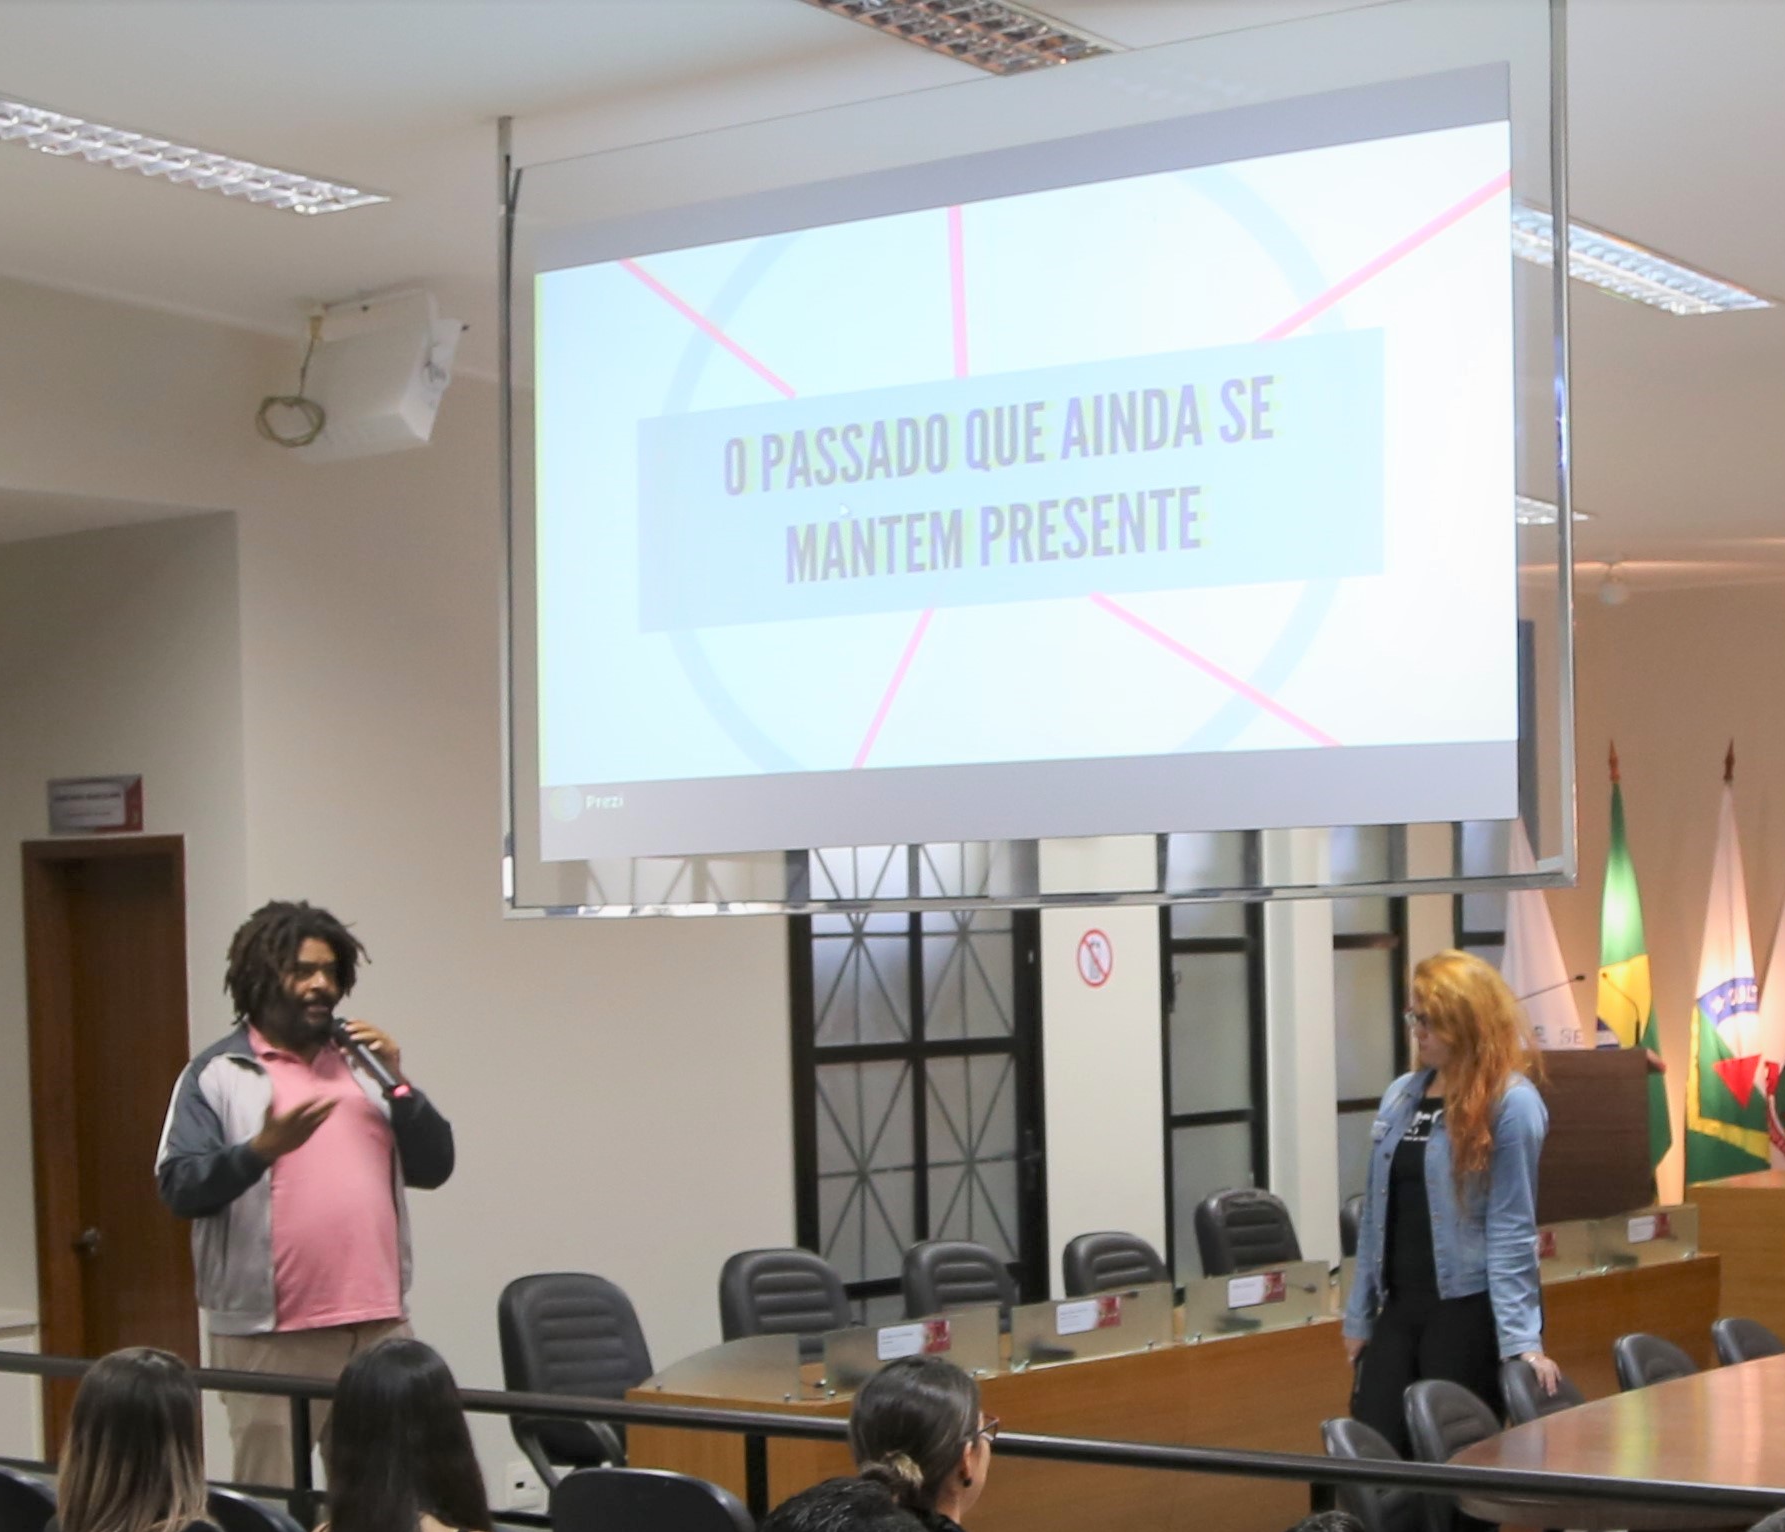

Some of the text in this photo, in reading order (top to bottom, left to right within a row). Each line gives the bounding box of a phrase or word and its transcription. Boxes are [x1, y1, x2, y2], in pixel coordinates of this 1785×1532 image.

[724, 374, 1275, 497] O PASSADO QUE AINDA SE
[785, 485, 1203, 585] MANTEM PRESENTE
